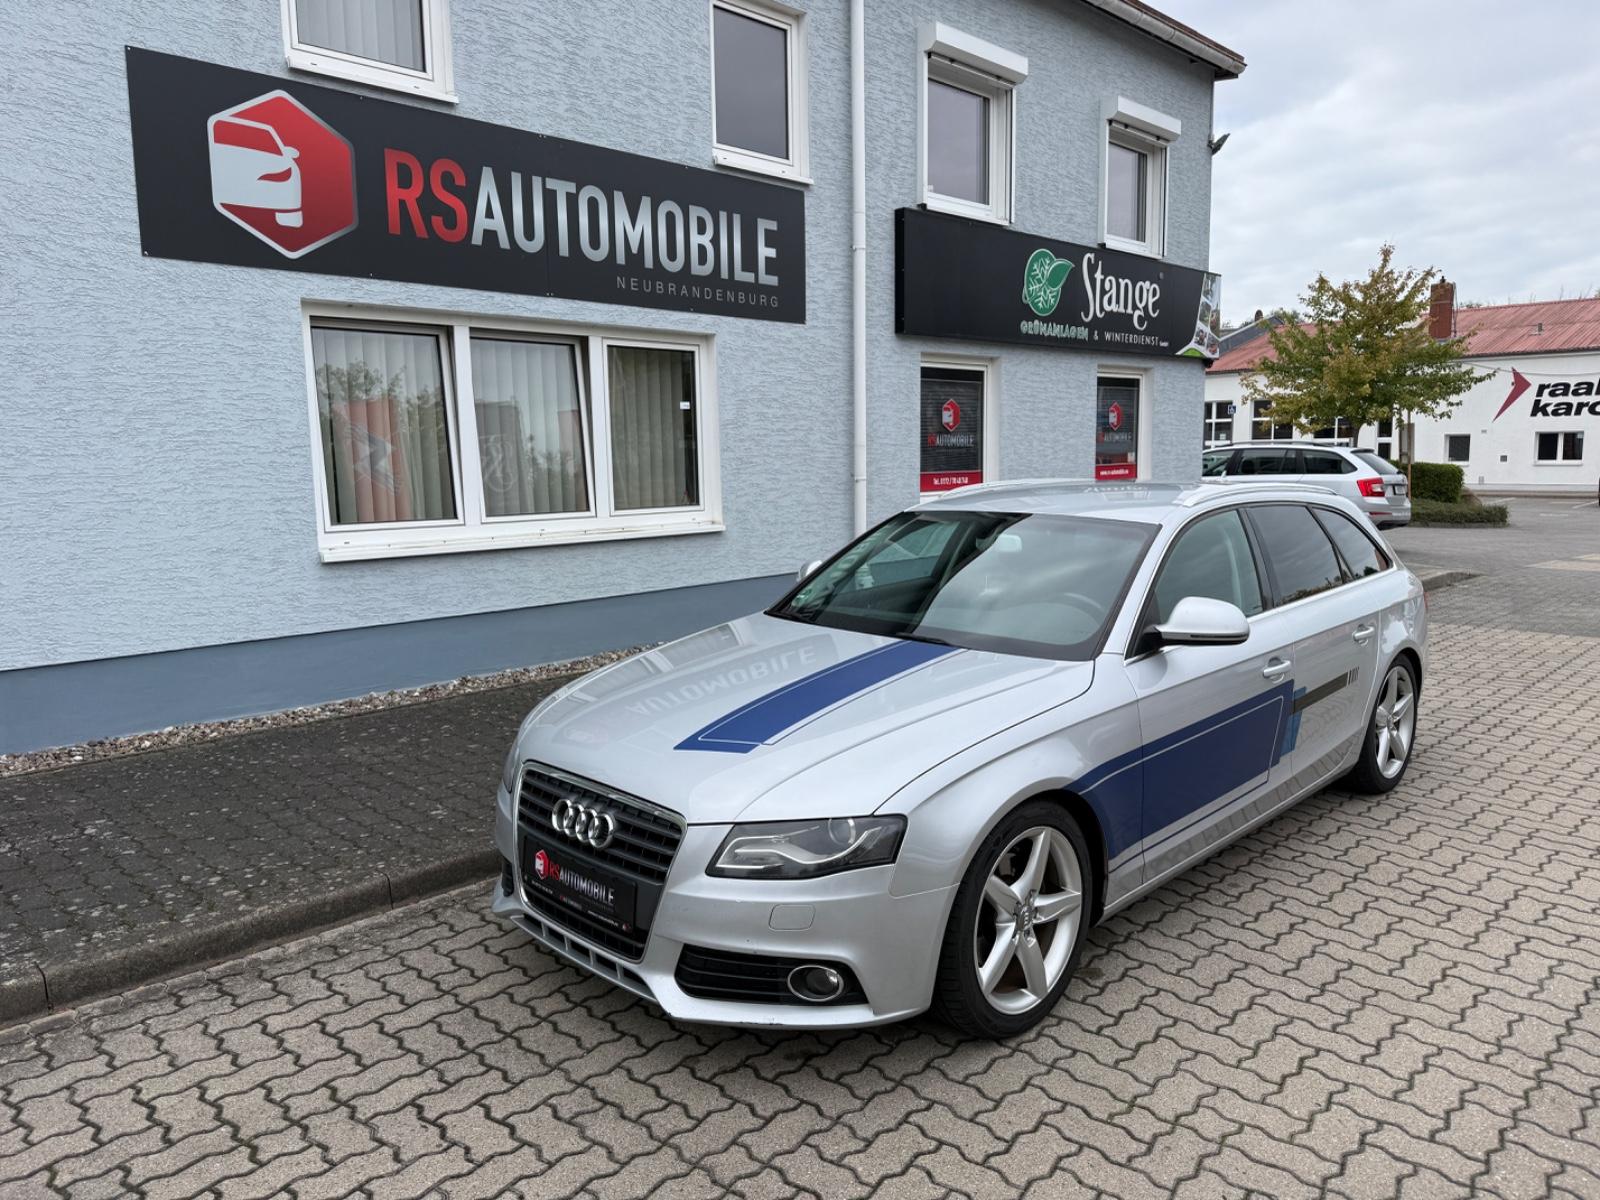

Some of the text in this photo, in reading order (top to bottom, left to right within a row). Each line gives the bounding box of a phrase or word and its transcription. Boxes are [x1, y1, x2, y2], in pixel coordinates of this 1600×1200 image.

[384, 148, 779, 287] RSAUTOMOBILE
[616, 276, 779, 307] NEUBRANDENBURG
[1081, 253, 1160, 331] Stange
[1093, 330, 1099, 340] &
[1105, 331, 1159, 346] WINTERDIENST
[549, 861, 615, 906] RSAUTOMOBILE
